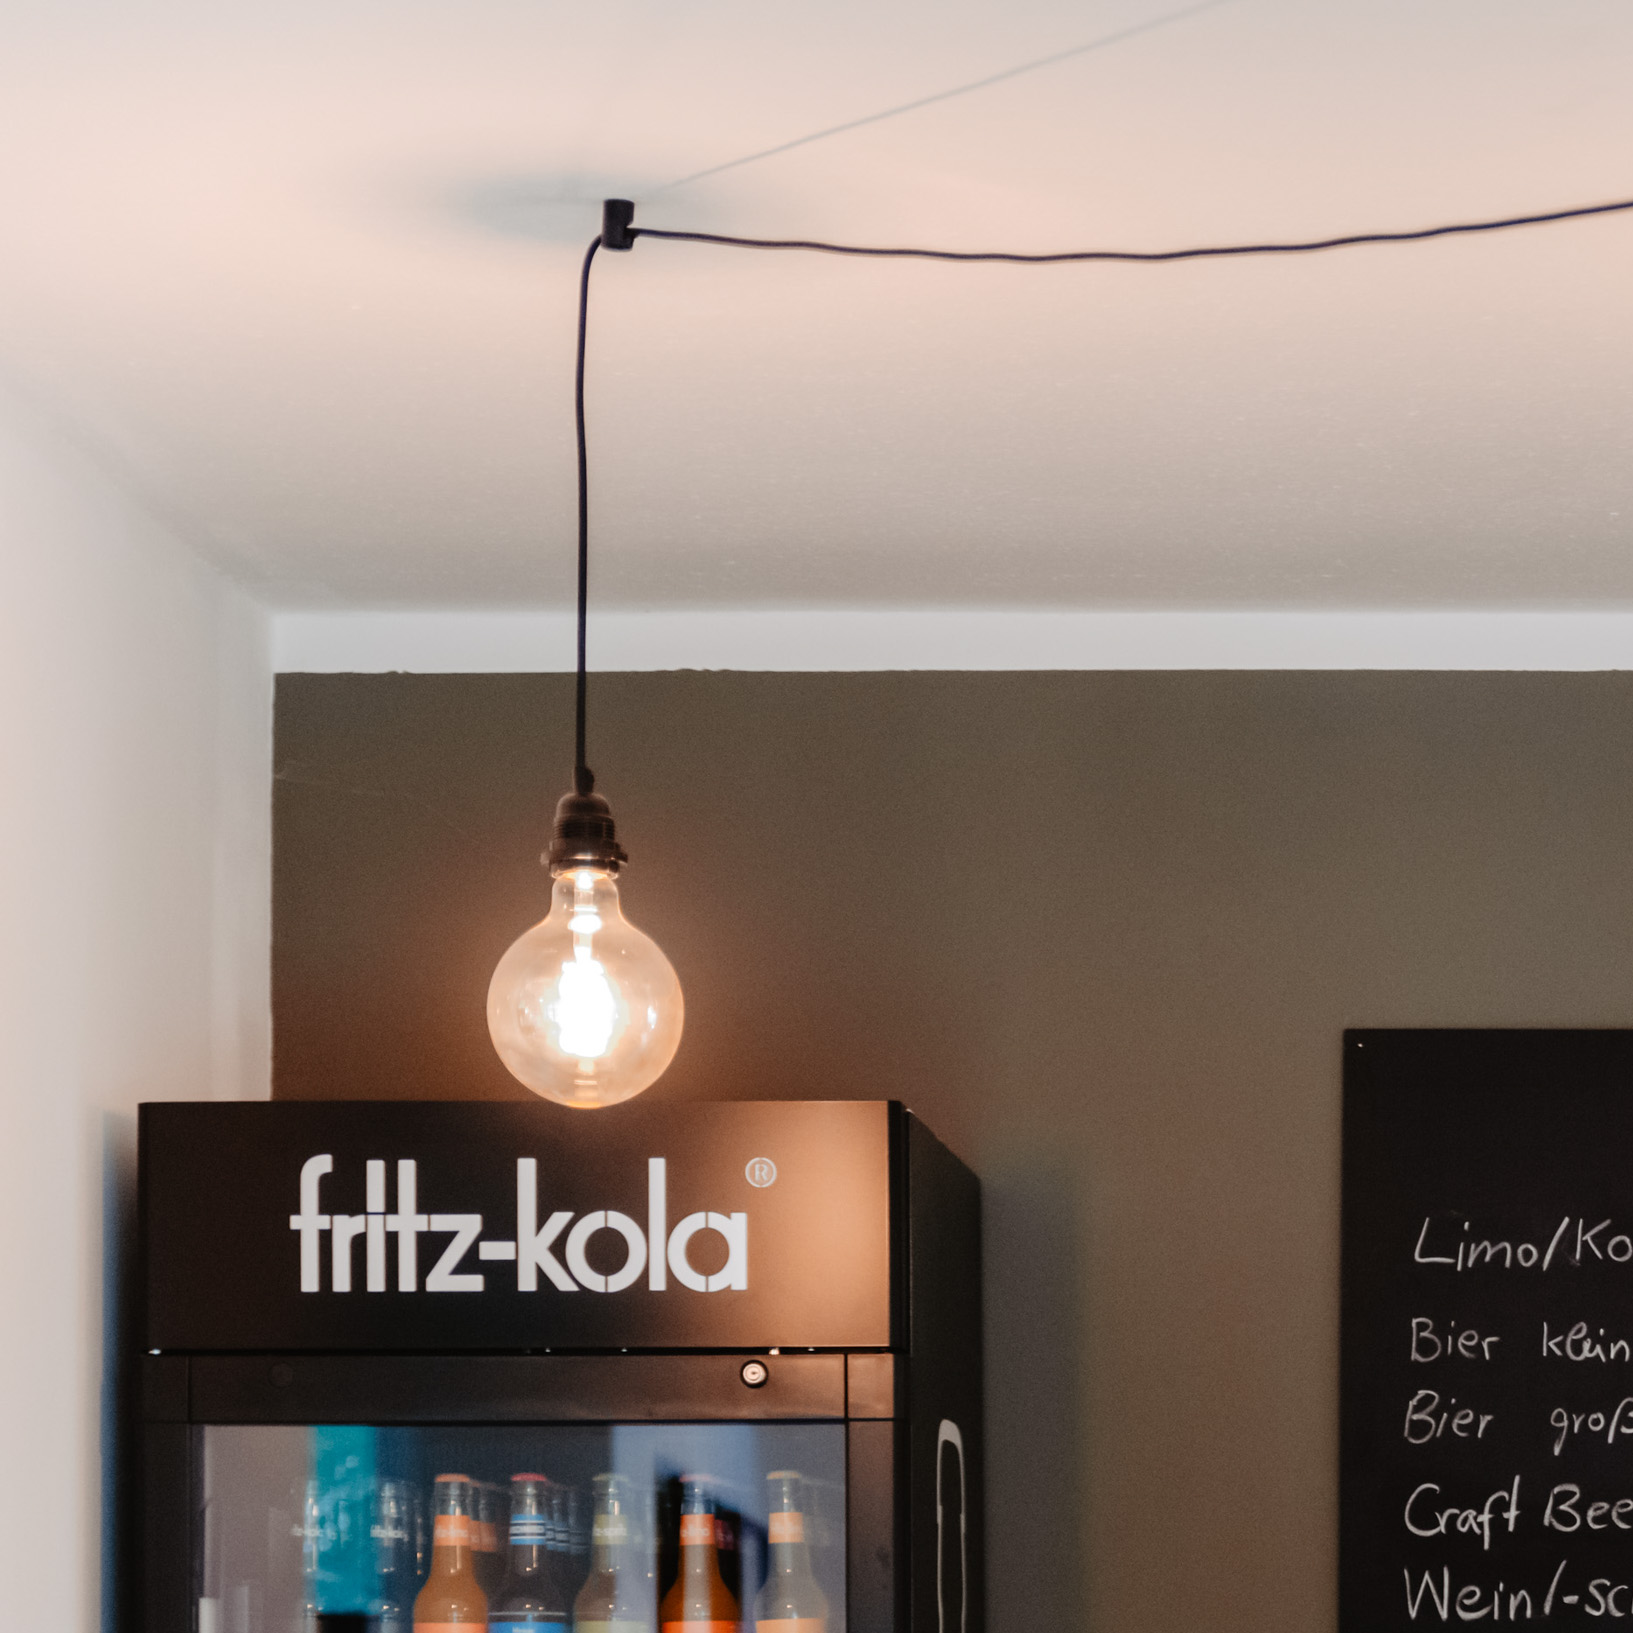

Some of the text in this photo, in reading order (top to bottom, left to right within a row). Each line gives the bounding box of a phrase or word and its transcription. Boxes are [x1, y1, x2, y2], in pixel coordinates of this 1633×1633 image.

[1411, 1317, 1499, 1362] Bier
[1543, 1322, 1630, 1362] klein
[1404, 1390, 1493, 1444] Bier
[1405, 1475, 1520, 1550] Craft
